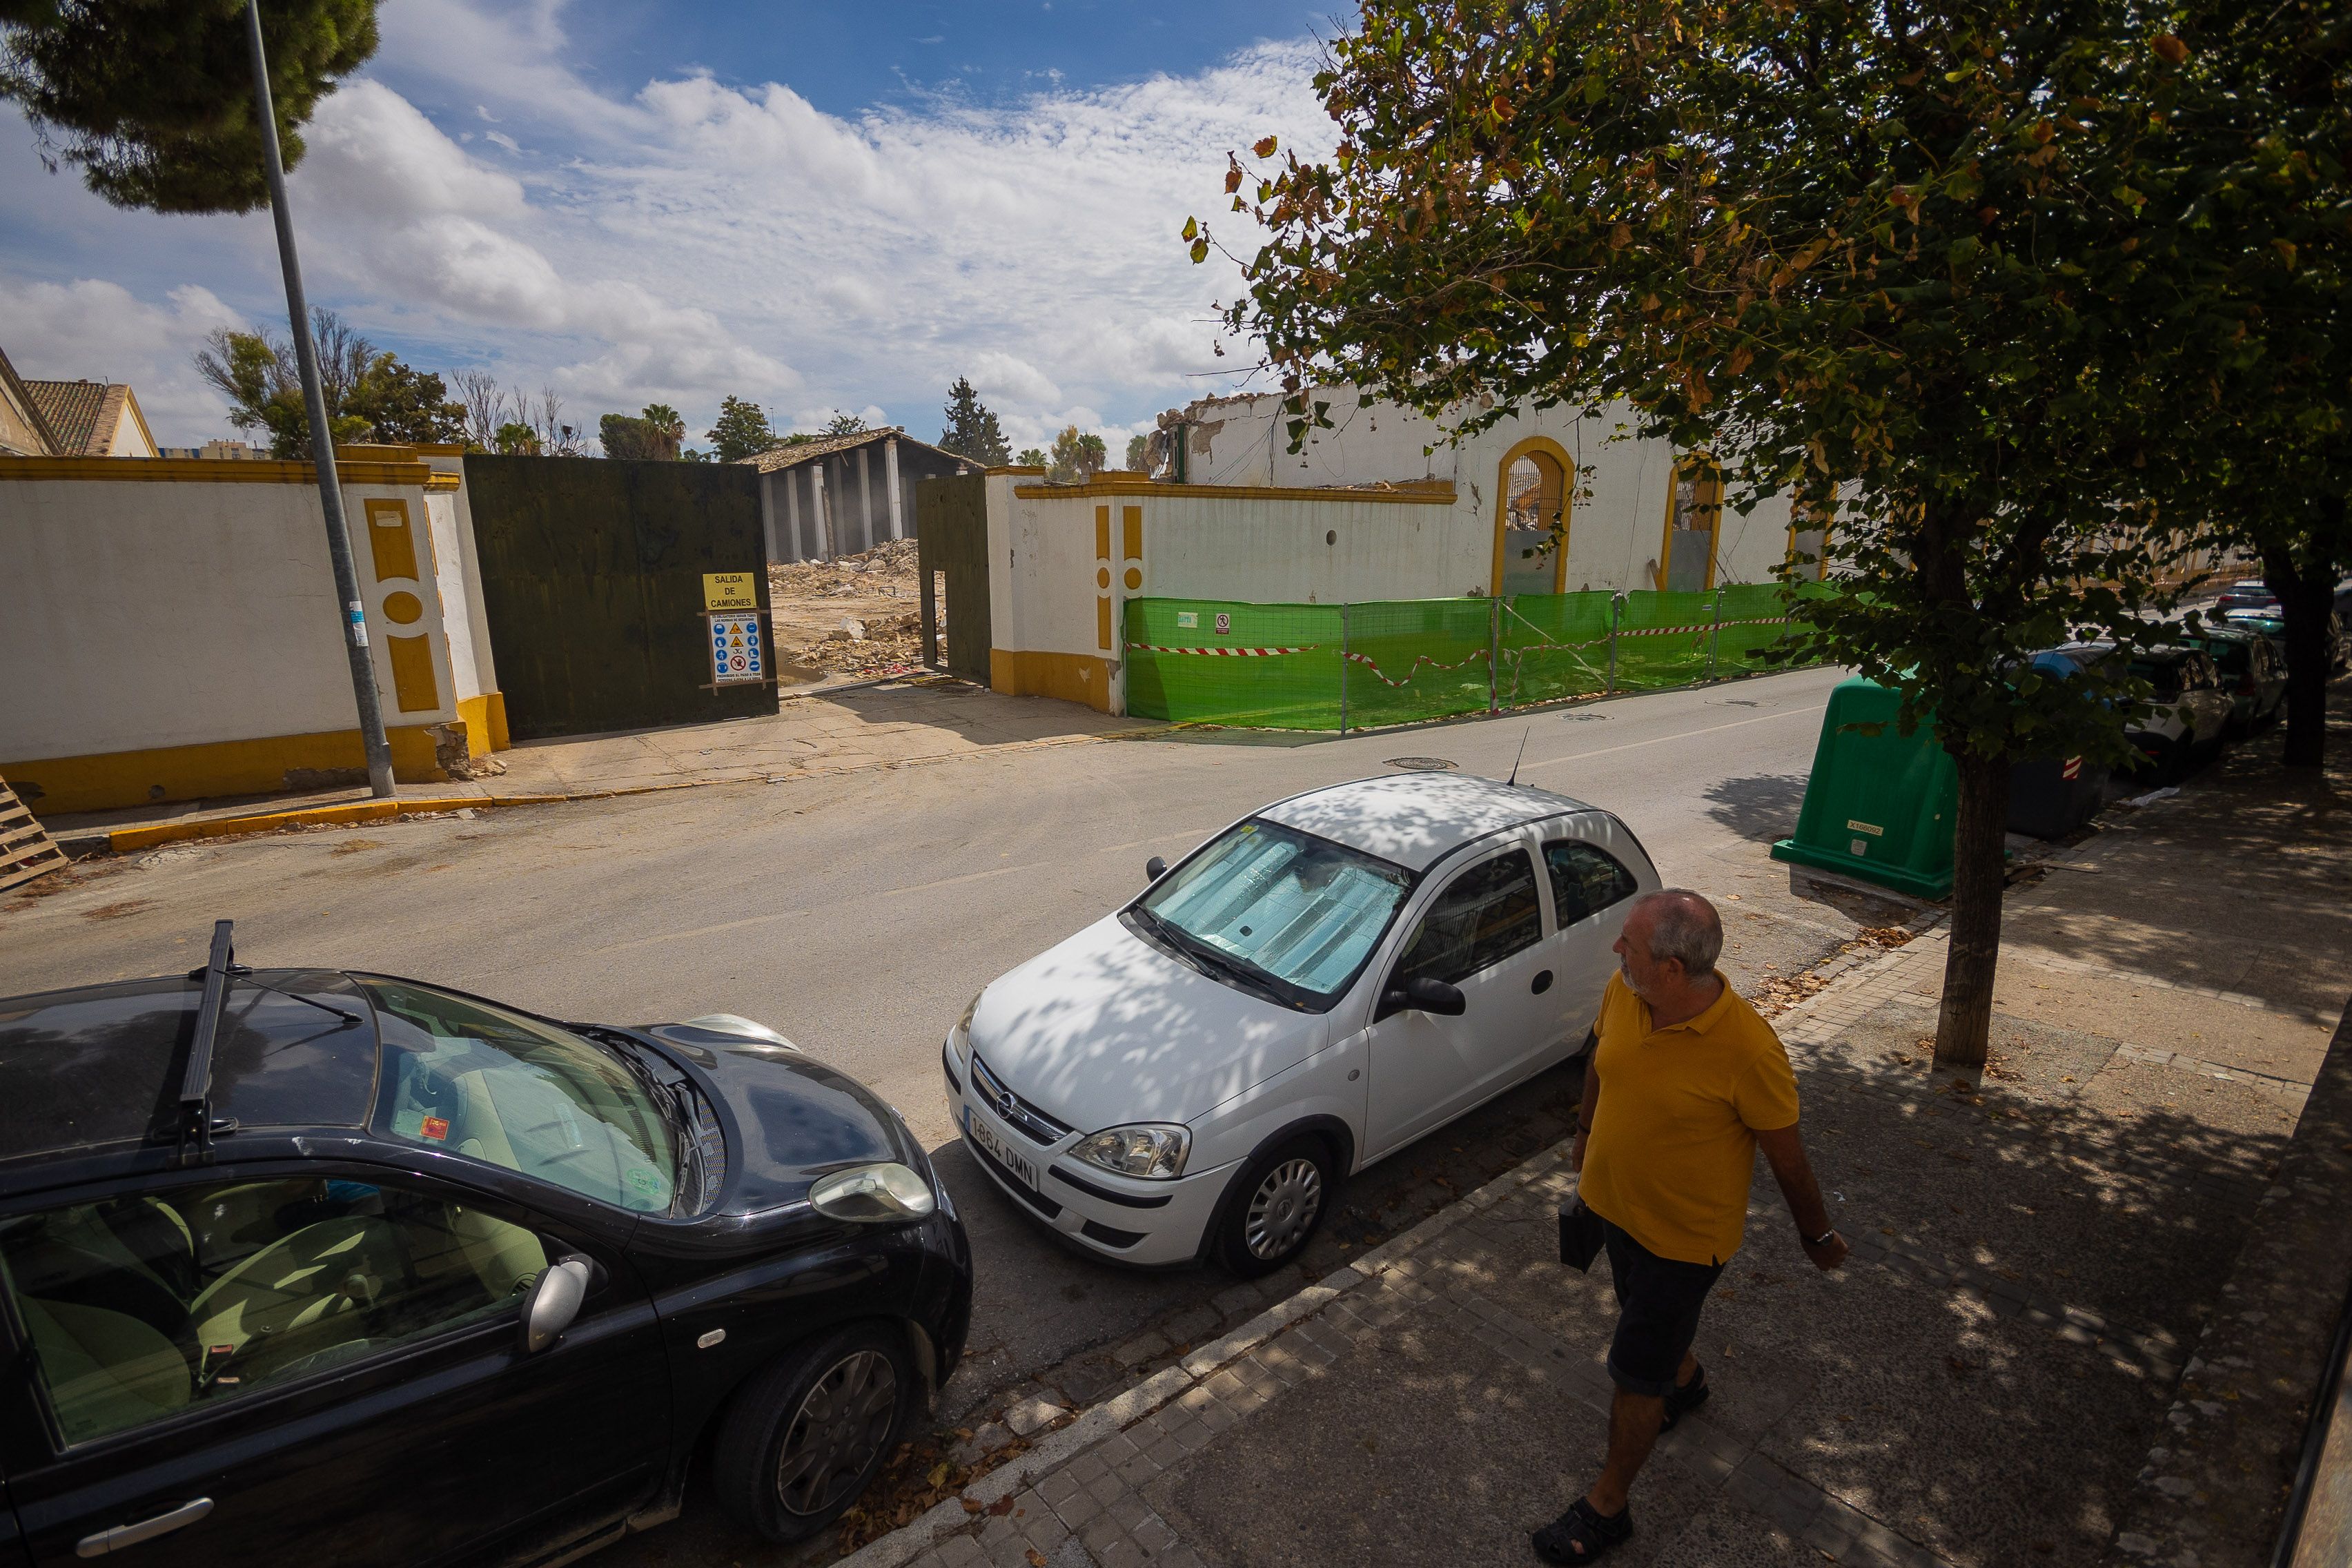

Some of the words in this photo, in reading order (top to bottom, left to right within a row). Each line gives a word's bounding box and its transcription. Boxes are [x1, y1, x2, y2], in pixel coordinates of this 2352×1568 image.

[711, 598, 751, 607] CAMIONES
[1850, 821, 1881, 834] X166092
[1006, 1146, 1032, 1185] DMN
